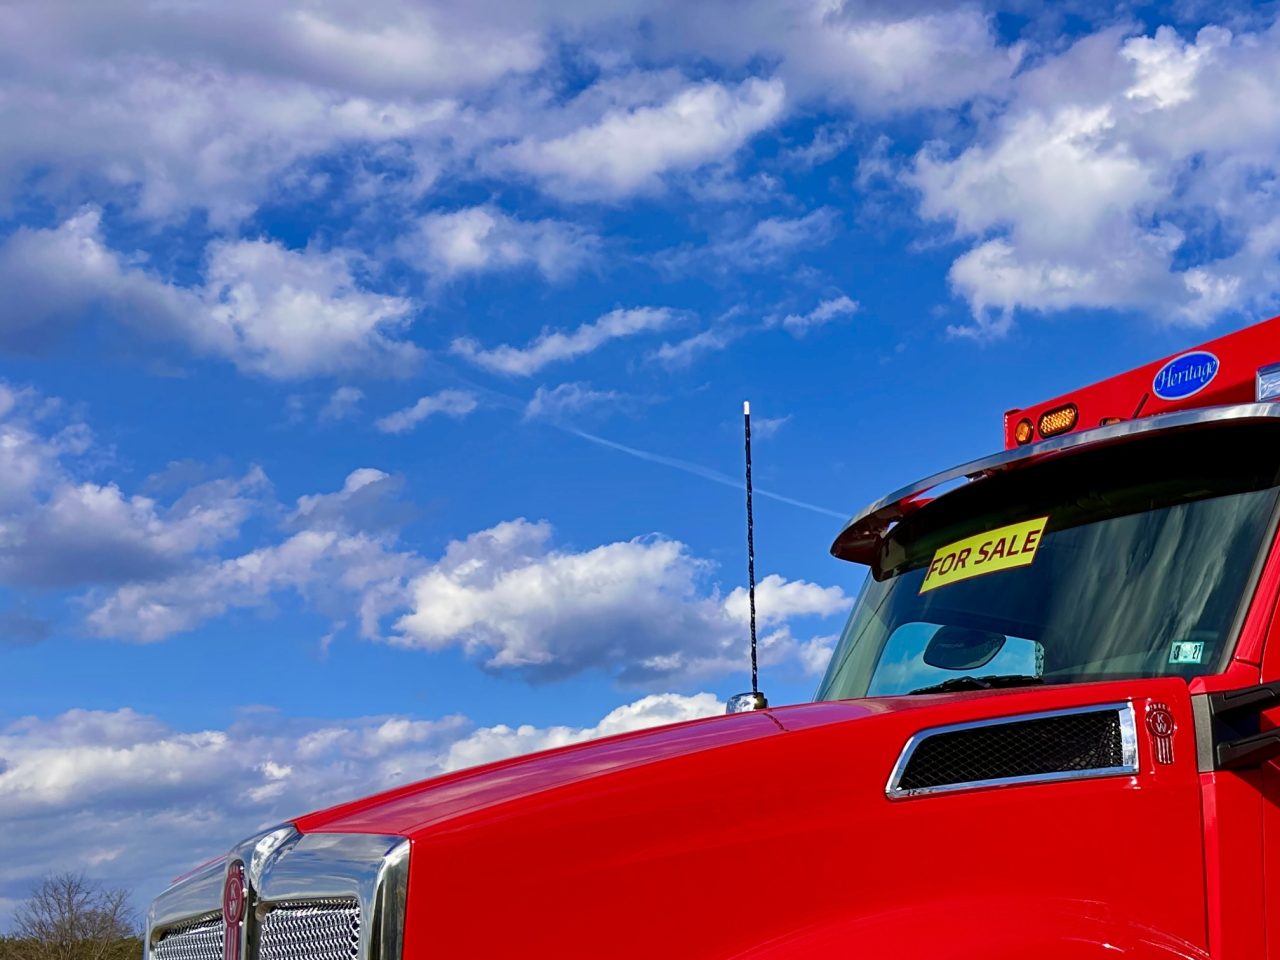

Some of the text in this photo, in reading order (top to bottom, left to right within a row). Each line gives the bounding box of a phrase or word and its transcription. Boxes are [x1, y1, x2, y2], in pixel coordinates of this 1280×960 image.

[1156, 360, 1216, 391] Heritage
[925, 529, 1042, 581] FOR SALE
